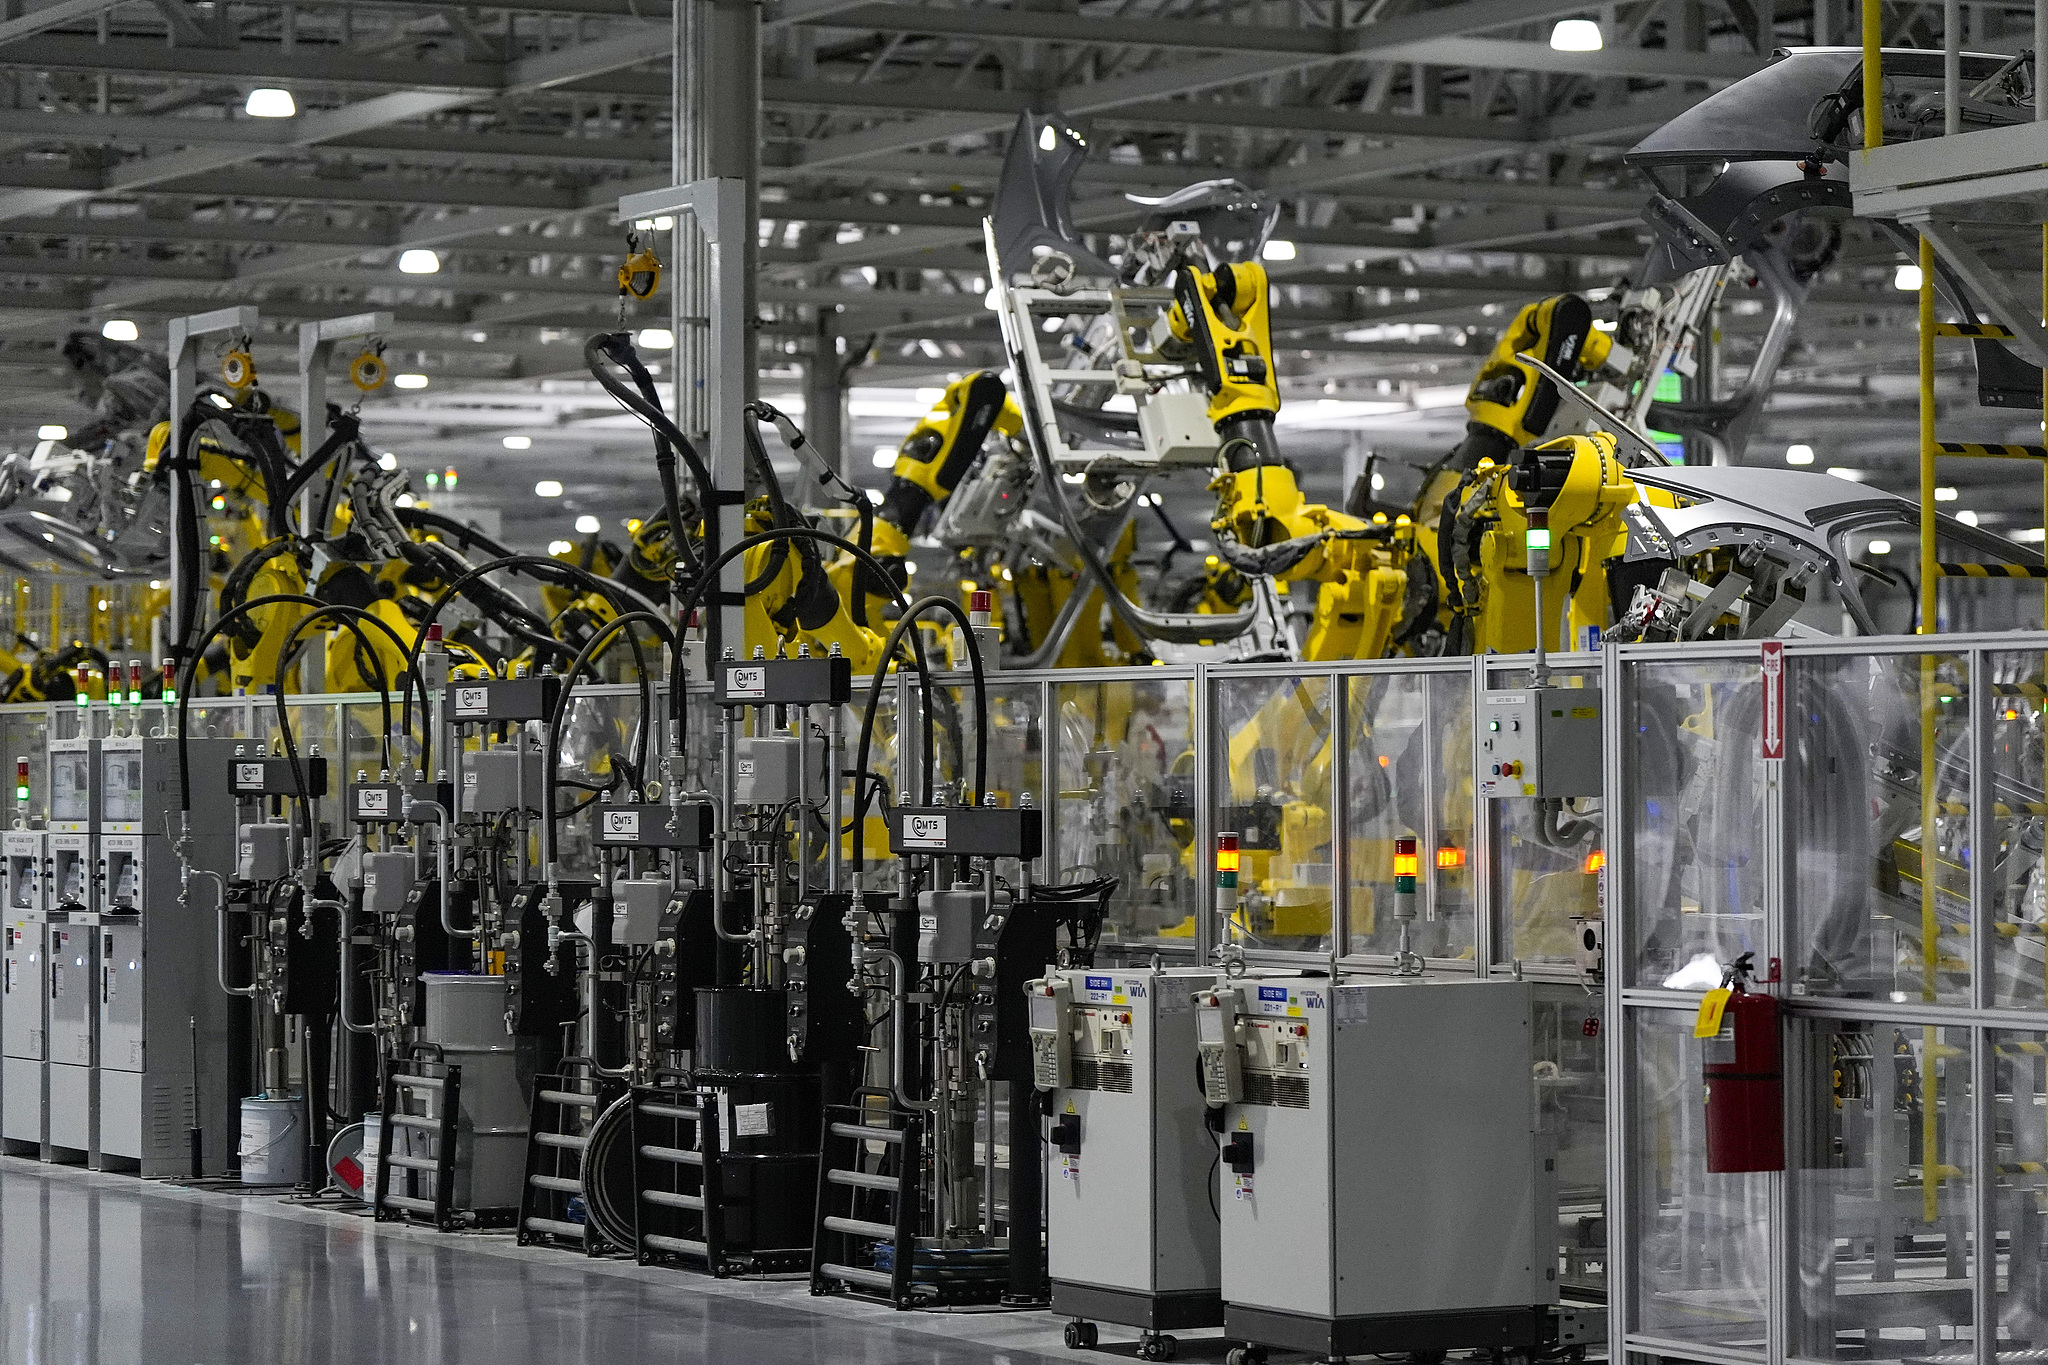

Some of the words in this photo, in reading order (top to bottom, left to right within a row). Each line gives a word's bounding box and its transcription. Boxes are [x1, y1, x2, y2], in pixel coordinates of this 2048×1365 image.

[1766, 659, 1778, 672] FIRE
[916, 820, 938, 830] DMTS
[1130, 984, 1147, 998] WIA
[1263, 990, 1275, 998] SIDE
[1275, 990, 1283, 998] RH
[1306, 994, 1324, 1009] WIA
